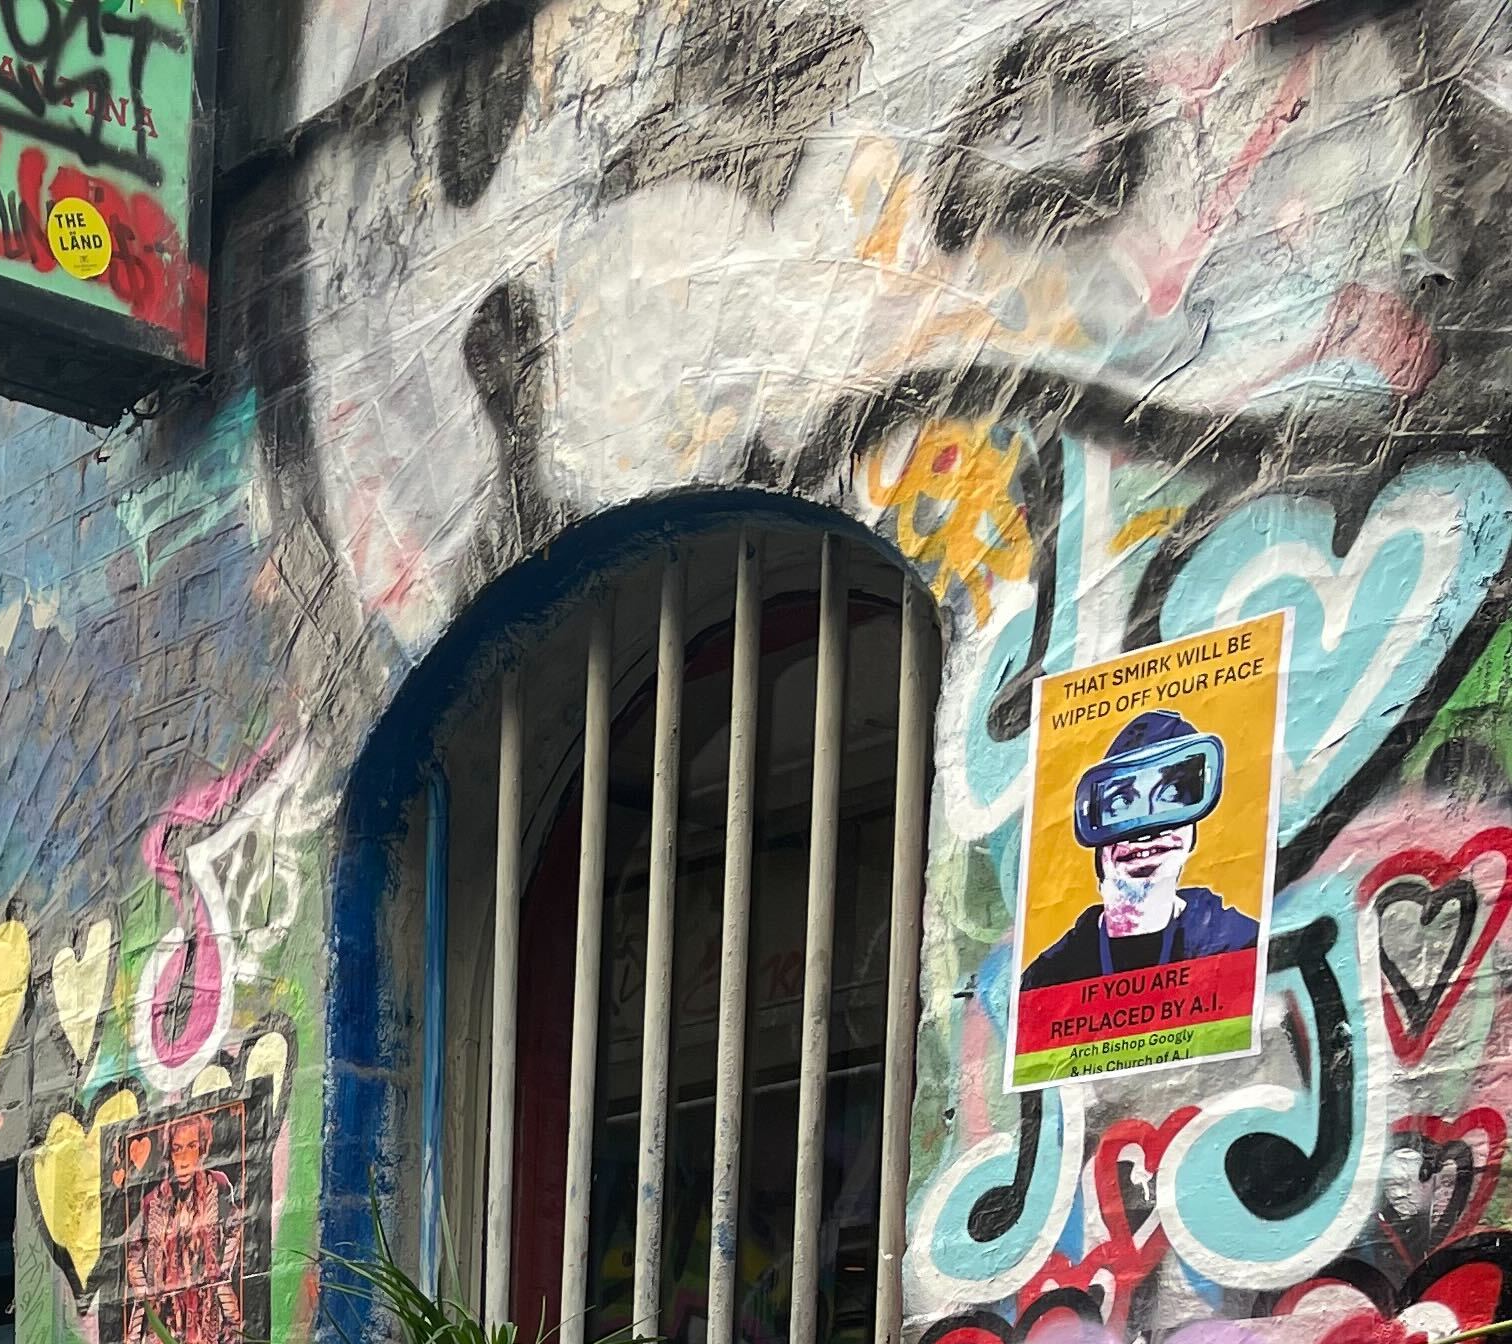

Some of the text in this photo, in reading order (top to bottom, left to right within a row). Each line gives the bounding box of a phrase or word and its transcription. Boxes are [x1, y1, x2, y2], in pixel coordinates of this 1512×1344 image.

[54, 213, 86, 229] THE
[59, 231, 103, 251] LÄND
[1064, 632, 1253, 699] THAT SMIRK WILL BE
[1051, 657, 1264, 731] WIPED OFF YOUR FACE
[1080, 967, 1191, 1005] IF YOU ARE
[1049, 992, 1224, 1040] REPLACED BY A.I.
[1069, 1028, 1195, 1059] Arch Bishop Googly
[1070, 1045, 1194, 1078] & His Church of A.I.
